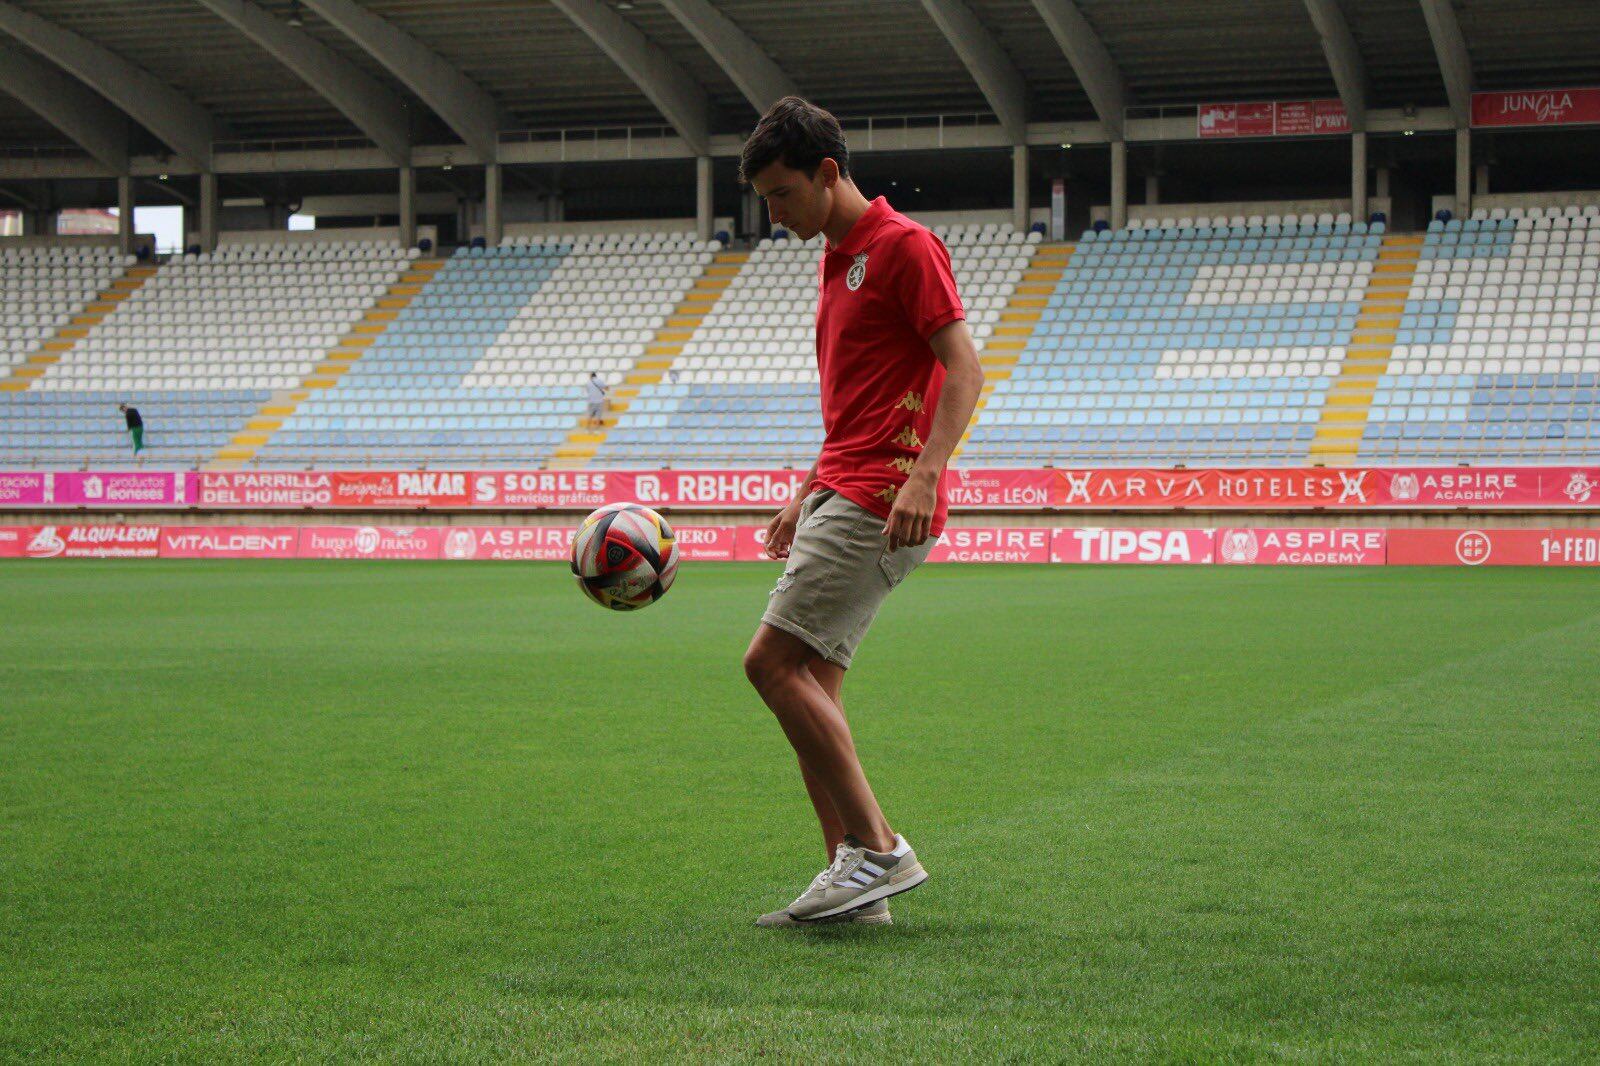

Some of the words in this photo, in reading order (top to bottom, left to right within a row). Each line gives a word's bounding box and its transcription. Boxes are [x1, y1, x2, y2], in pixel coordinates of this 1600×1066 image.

[109, 477, 164, 490] productos
[203, 475, 229, 488] LA
[234, 475, 331, 488] PARRILLA
[397, 473, 465, 496] PAKAR
[504, 474, 606, 491] SORLES
[1218, 478, 1333, 497] HOTELES
[1423, 472, 1517, 495] ASPIRE
[107, 487, 163, 500] leoneses
[203, 490, 241, 503] DEL
[245, 487, 331, 504] HÚMEDO
[504, 492, 554, 503] servicios
[558, 491, 606, 505] gráficos
[987, 493, 1001, 503] DE
[1004, 485, 1048, 503] LEÓN
[1434, 490, 1504, 500] ACADEMY
[167, 535, 292, 550] VITALDENT
[311, 533, 354, 551] burgo
[934, 528, 1044, 550] ASPIRE
[1073, 528, 1190, 561] TIPSA
[1263, 530, 1380, 552] ASPIRE
[492, 549, 568, 559] ACADEMY
[947, 551, 1030, 562] ACADEMY
[1277, 552, 1366, 563] ACADEMY
